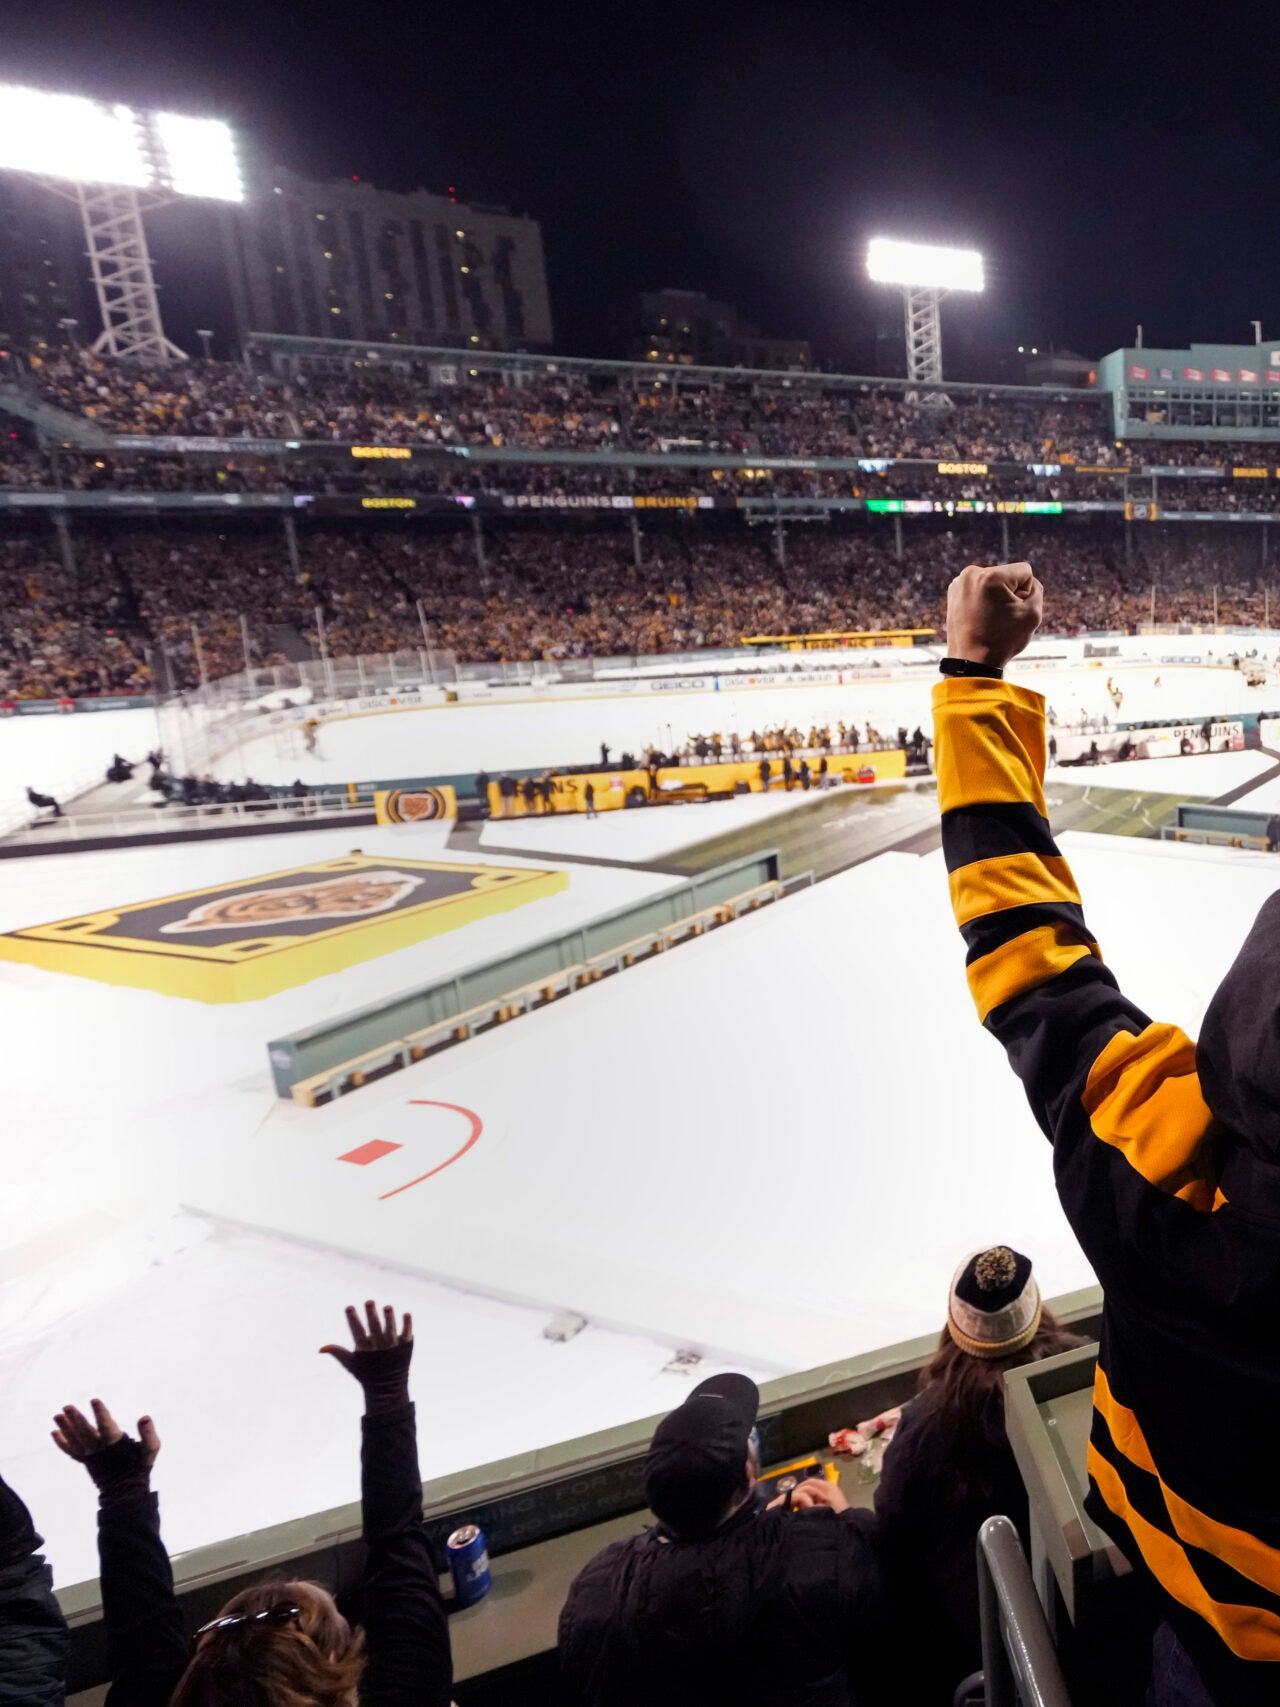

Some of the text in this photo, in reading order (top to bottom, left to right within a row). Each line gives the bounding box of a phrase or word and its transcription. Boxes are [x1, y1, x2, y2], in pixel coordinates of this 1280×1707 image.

[352, 446, 412, 459] BOSTON
[937, 462, 988, 475] BOSTON
[517, 495, 612, 508] PENGUINS
[635, 496, 699, 508] BRUINS
[1161, 655, 1201, 664] GEICO
[650, 679, 705, 691] GEICO
[1174, 725, 1239, 738] PENUINS
